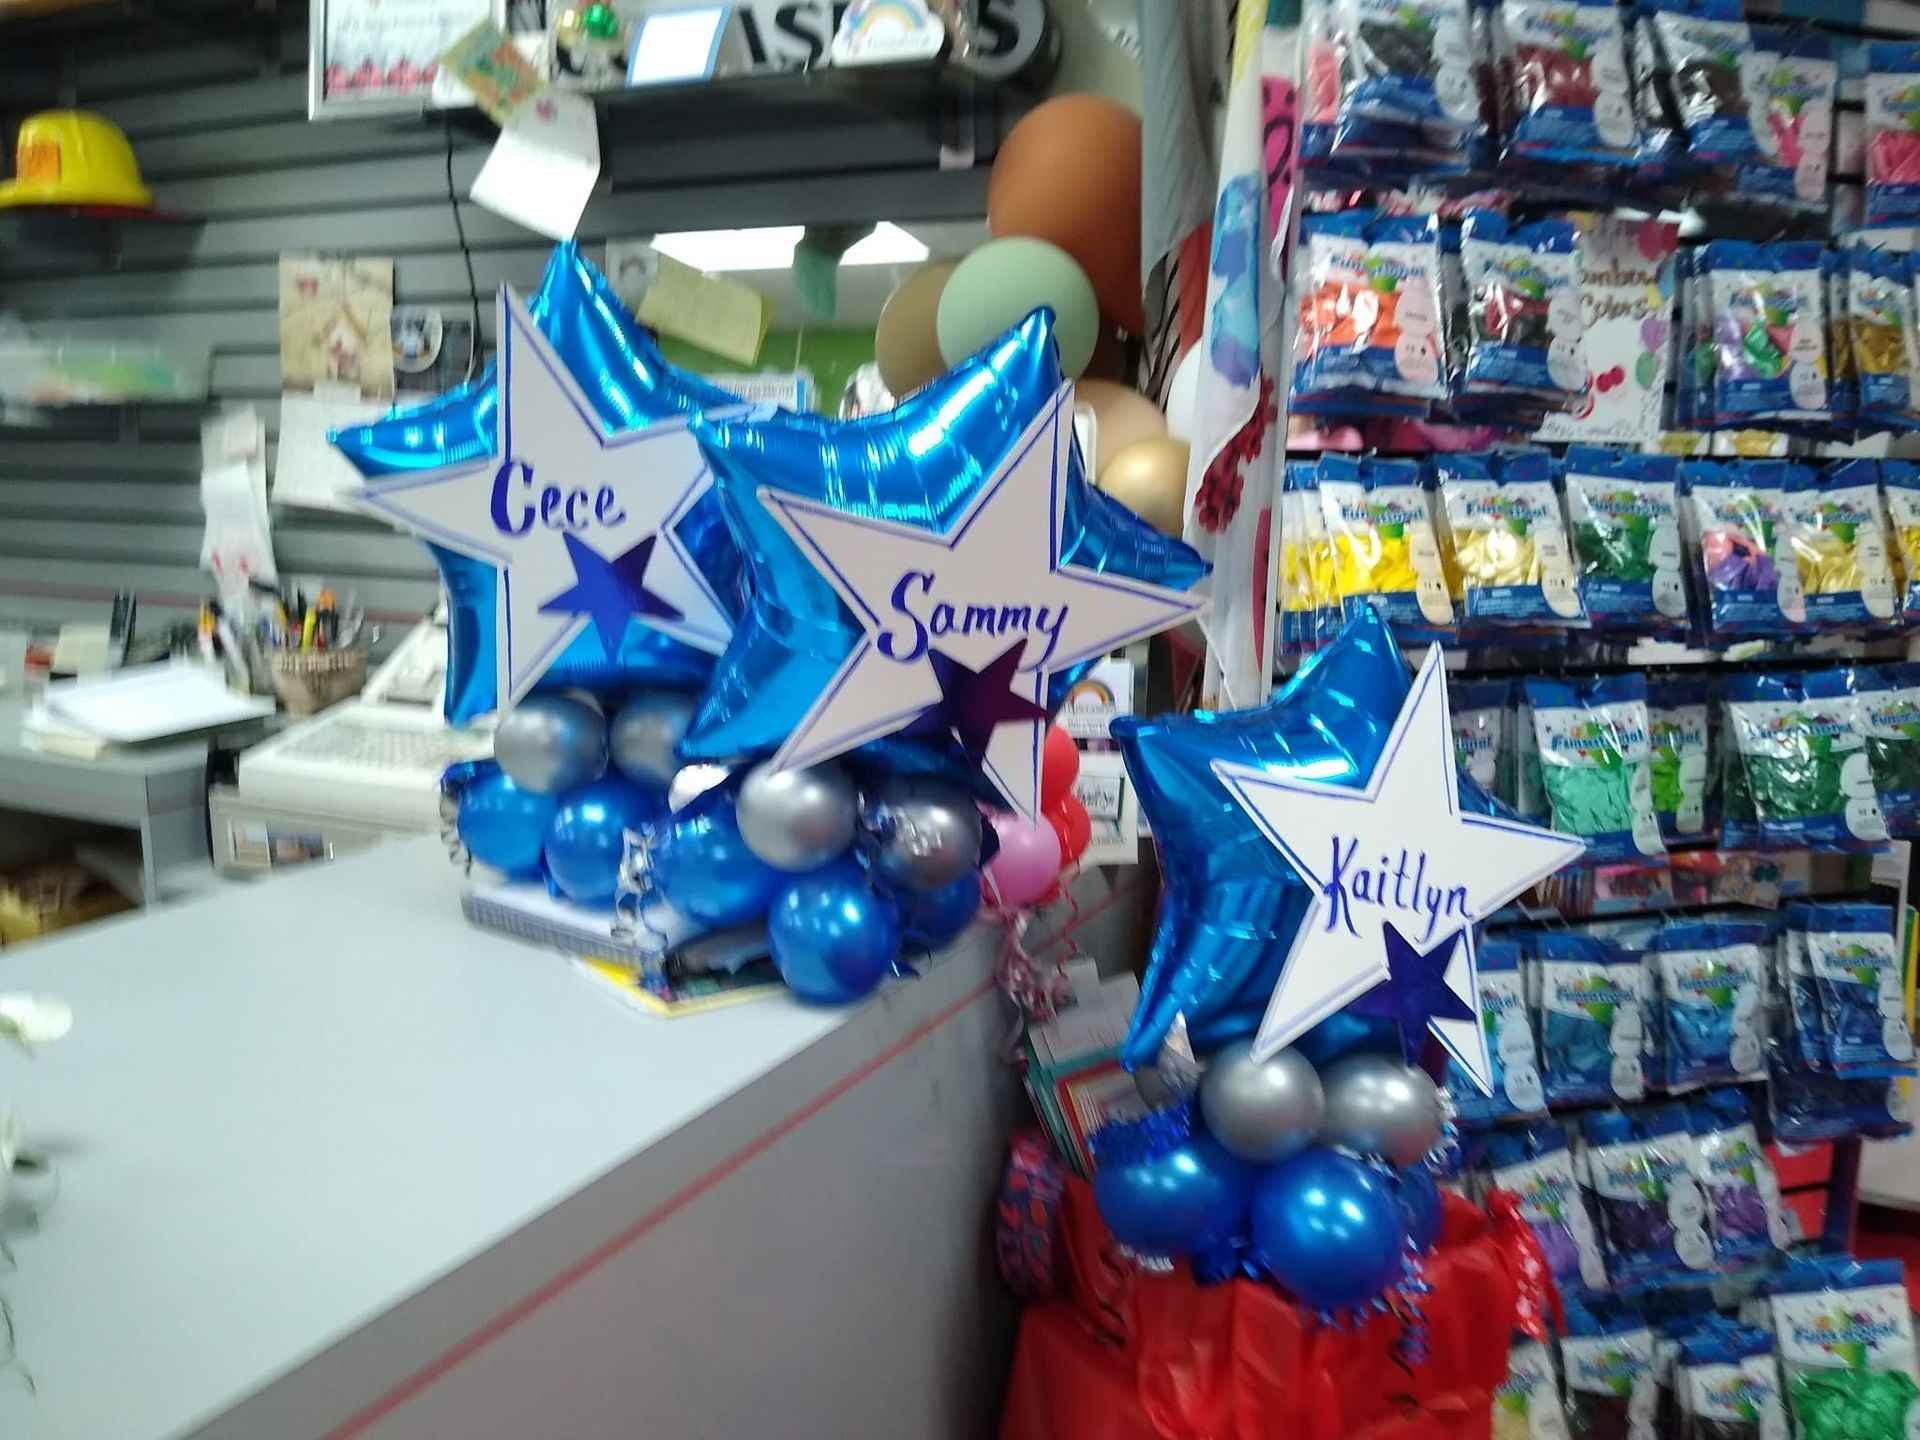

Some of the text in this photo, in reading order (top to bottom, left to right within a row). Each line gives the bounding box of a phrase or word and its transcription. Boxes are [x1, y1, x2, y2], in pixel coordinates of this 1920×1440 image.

[490, 461, 626, 537] Cece
[877, 571, 1069, 672] Sammy
[1323, 835, 1474, 945] Kaitlyn
